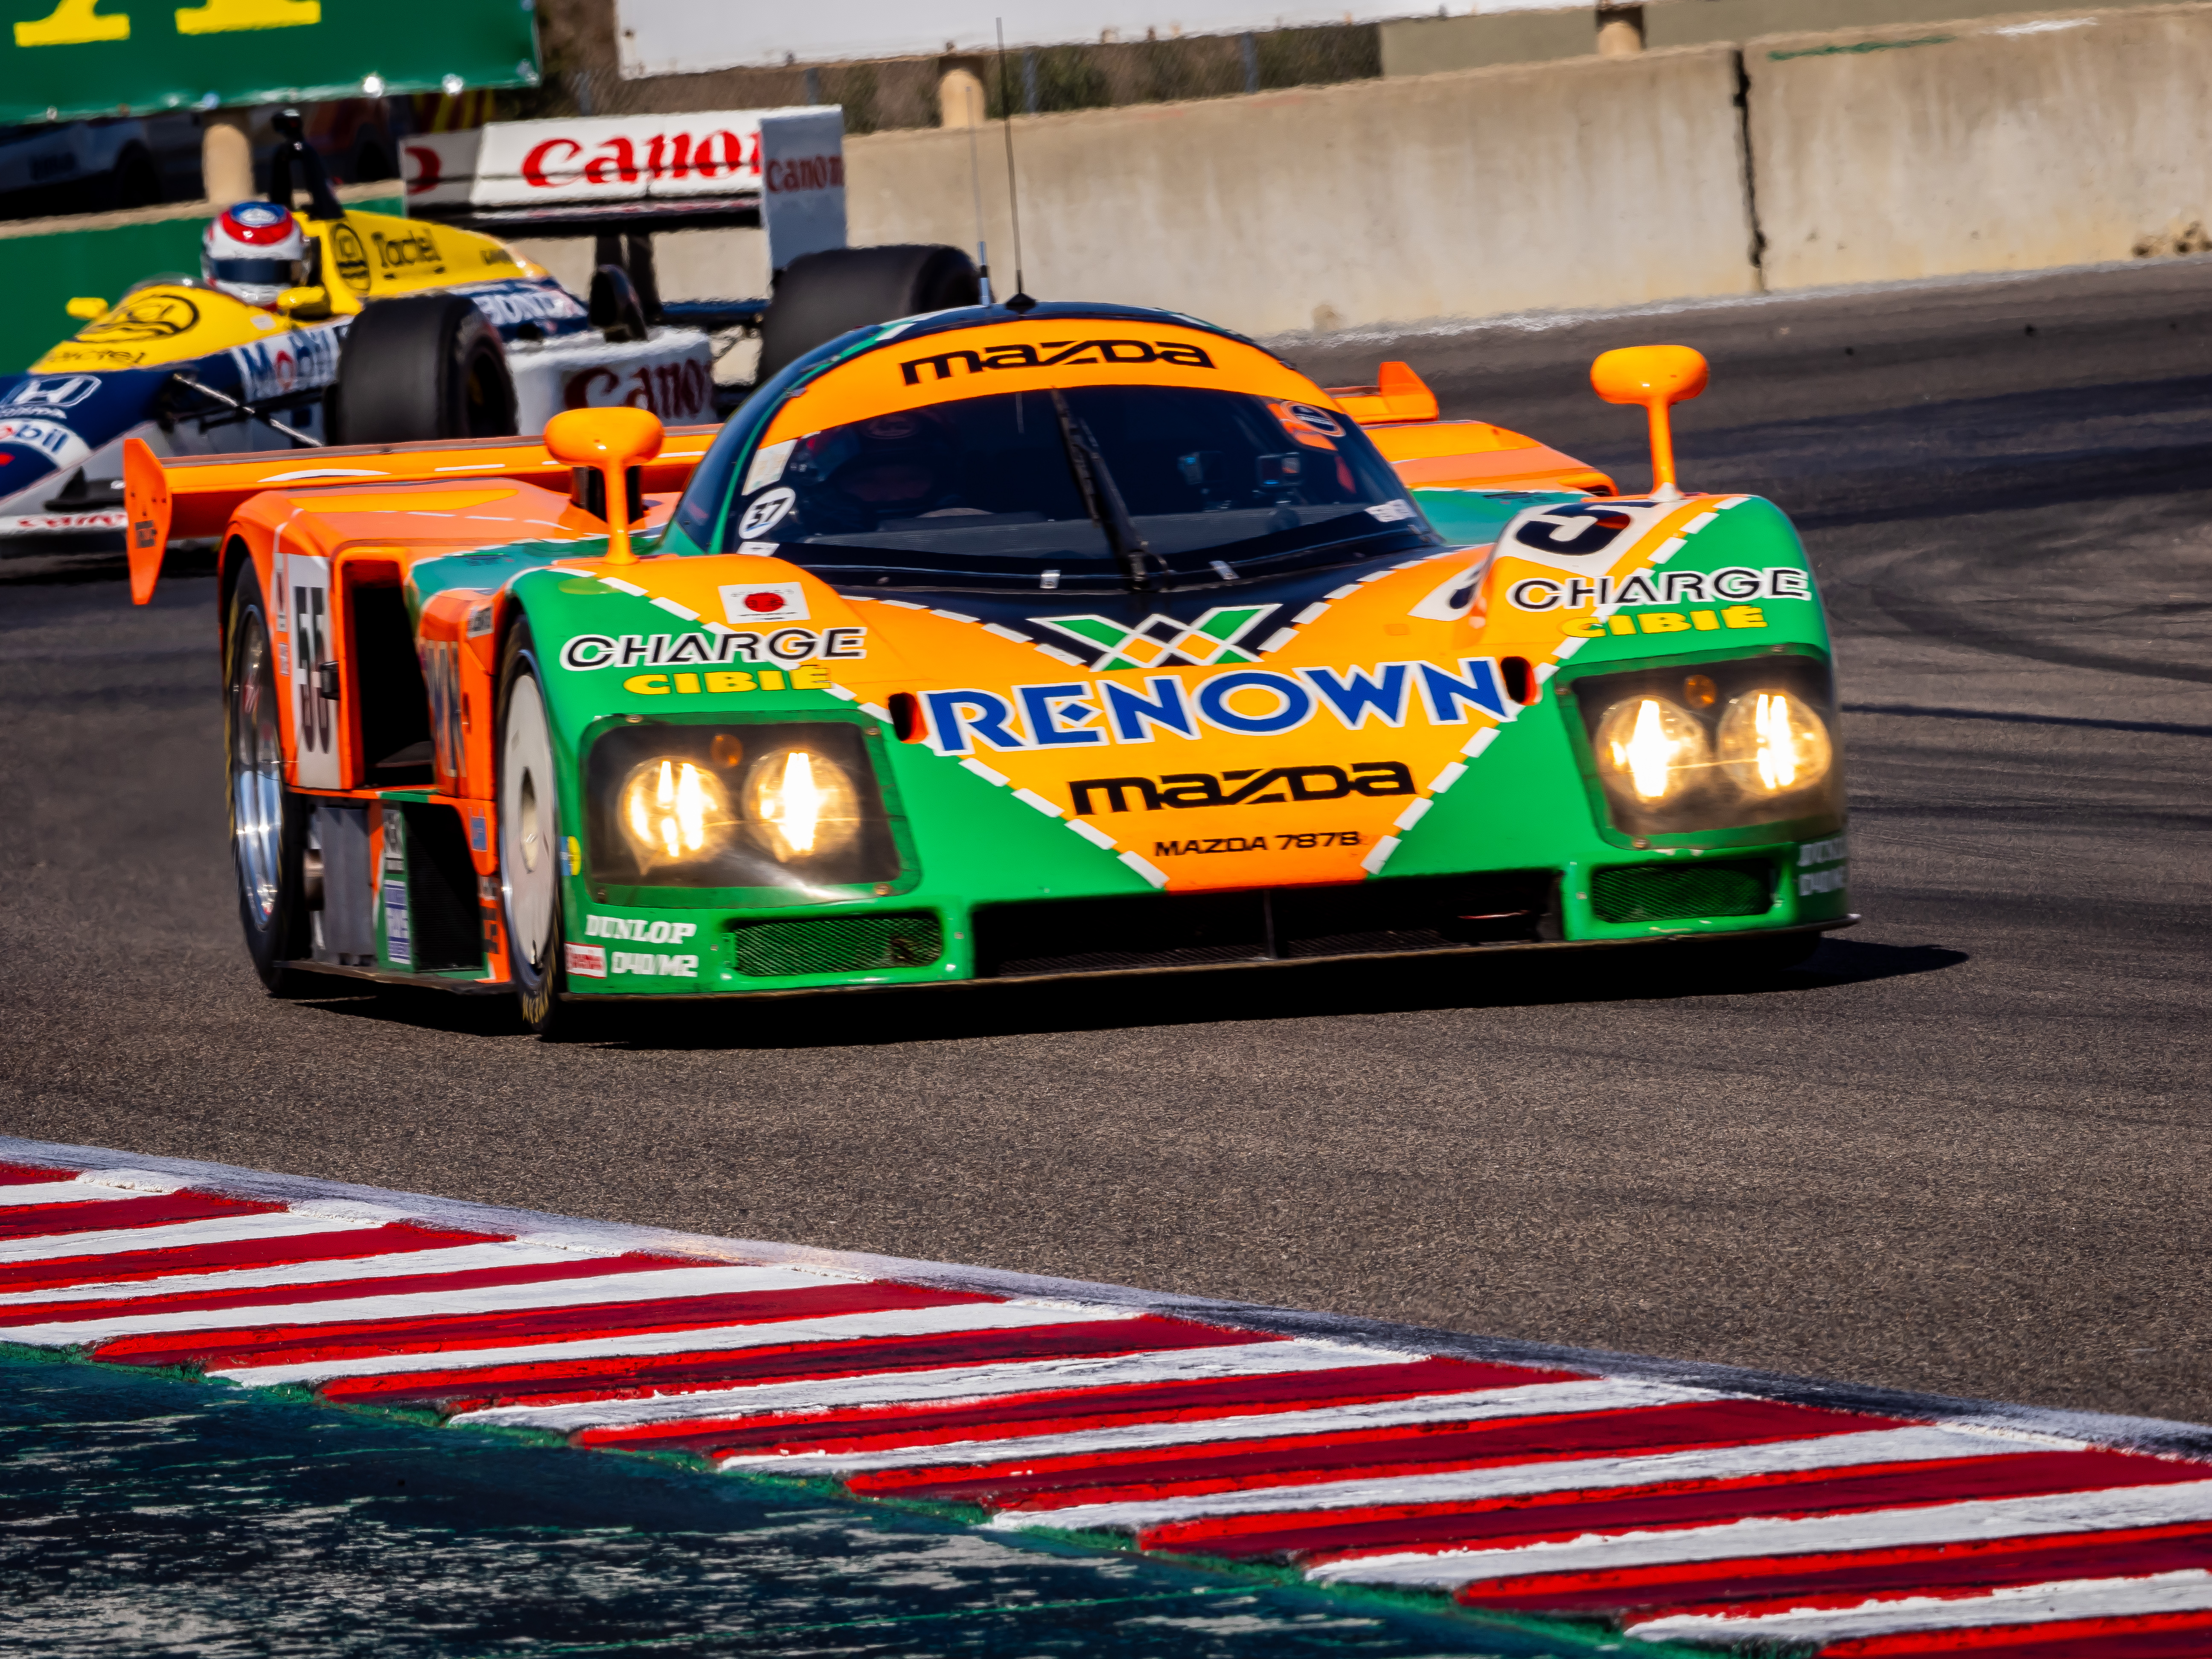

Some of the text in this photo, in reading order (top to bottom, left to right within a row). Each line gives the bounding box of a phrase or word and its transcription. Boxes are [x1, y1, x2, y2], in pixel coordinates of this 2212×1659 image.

[565, 358, 713, 419] Cano
[1506, 565, 1812, 612] CHARGE
[1560, 604, 1768, 638] CIBIÉ
[559, 626, 868, 672] CHARGE
[623, 664, 832, 696] CIBIÉ
[917, 656, 1517, 757] RENOWN
[1154, 830, 1361, 857] MAZDA 787B
[584, 914, 697, 944] DUNLOP
